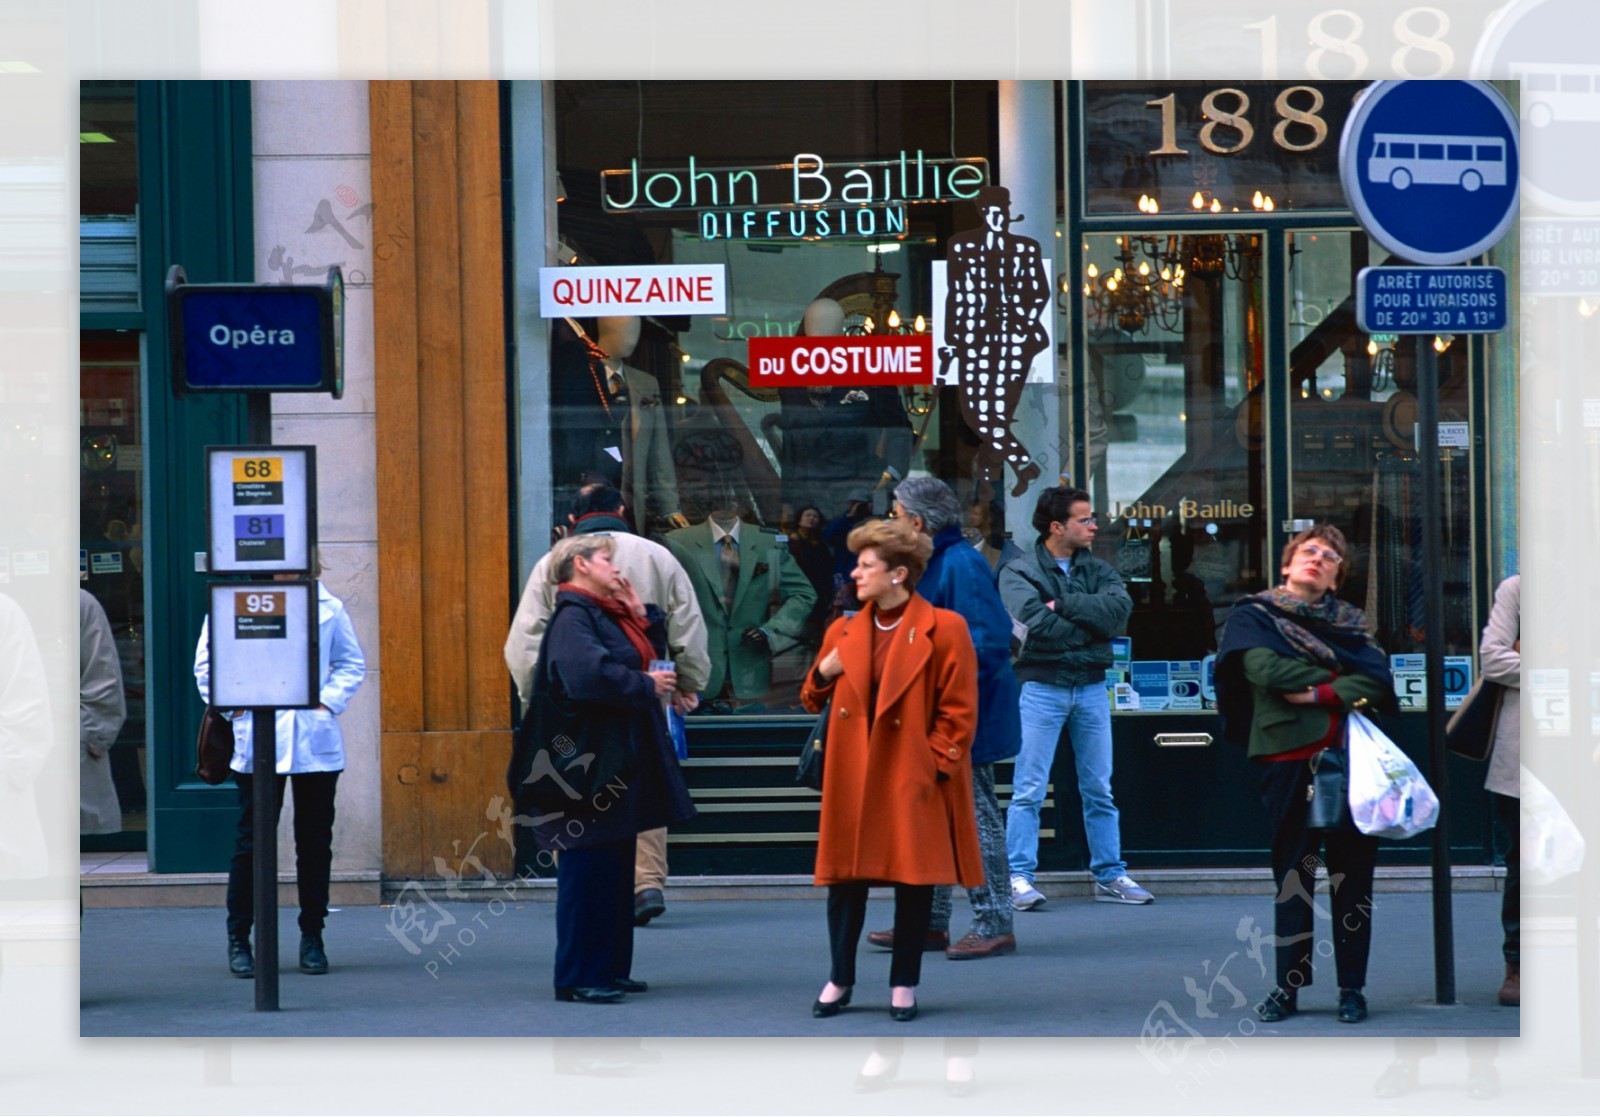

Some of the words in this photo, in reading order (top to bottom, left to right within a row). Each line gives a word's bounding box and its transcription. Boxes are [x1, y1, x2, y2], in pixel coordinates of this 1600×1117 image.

[1146, 86, 1366, 156] 188
[605, 156, 758, 208] John
[793, 149, 984, 204] Baillie
[702, 206, 904, 239] DIFFUSION
[552, 276, 714, 306] QUINZAINE
[1377, 273, 1422, 289] ARRÊT
[1373, 293, 1411, 307] POUR
[1417, 293, 1498, 307] LIVRAISONS
[1376, 312, 1394, 326] DE
[1432, 311, 1451, 325] 30
[1457, 311, 1467, 325] A
[209, 324, 295, 349] Opéra
[759, 358, 785, 375] DU
[791, 346, 923, 375] COSTUME
[244, 460, 271, 478] 68
[1106, 500, 1167, 519] John
[1182, 499, 1255, 519] Baillie
[247, 517, 273, 535] 81
[246, 594, 275, 613] 95
